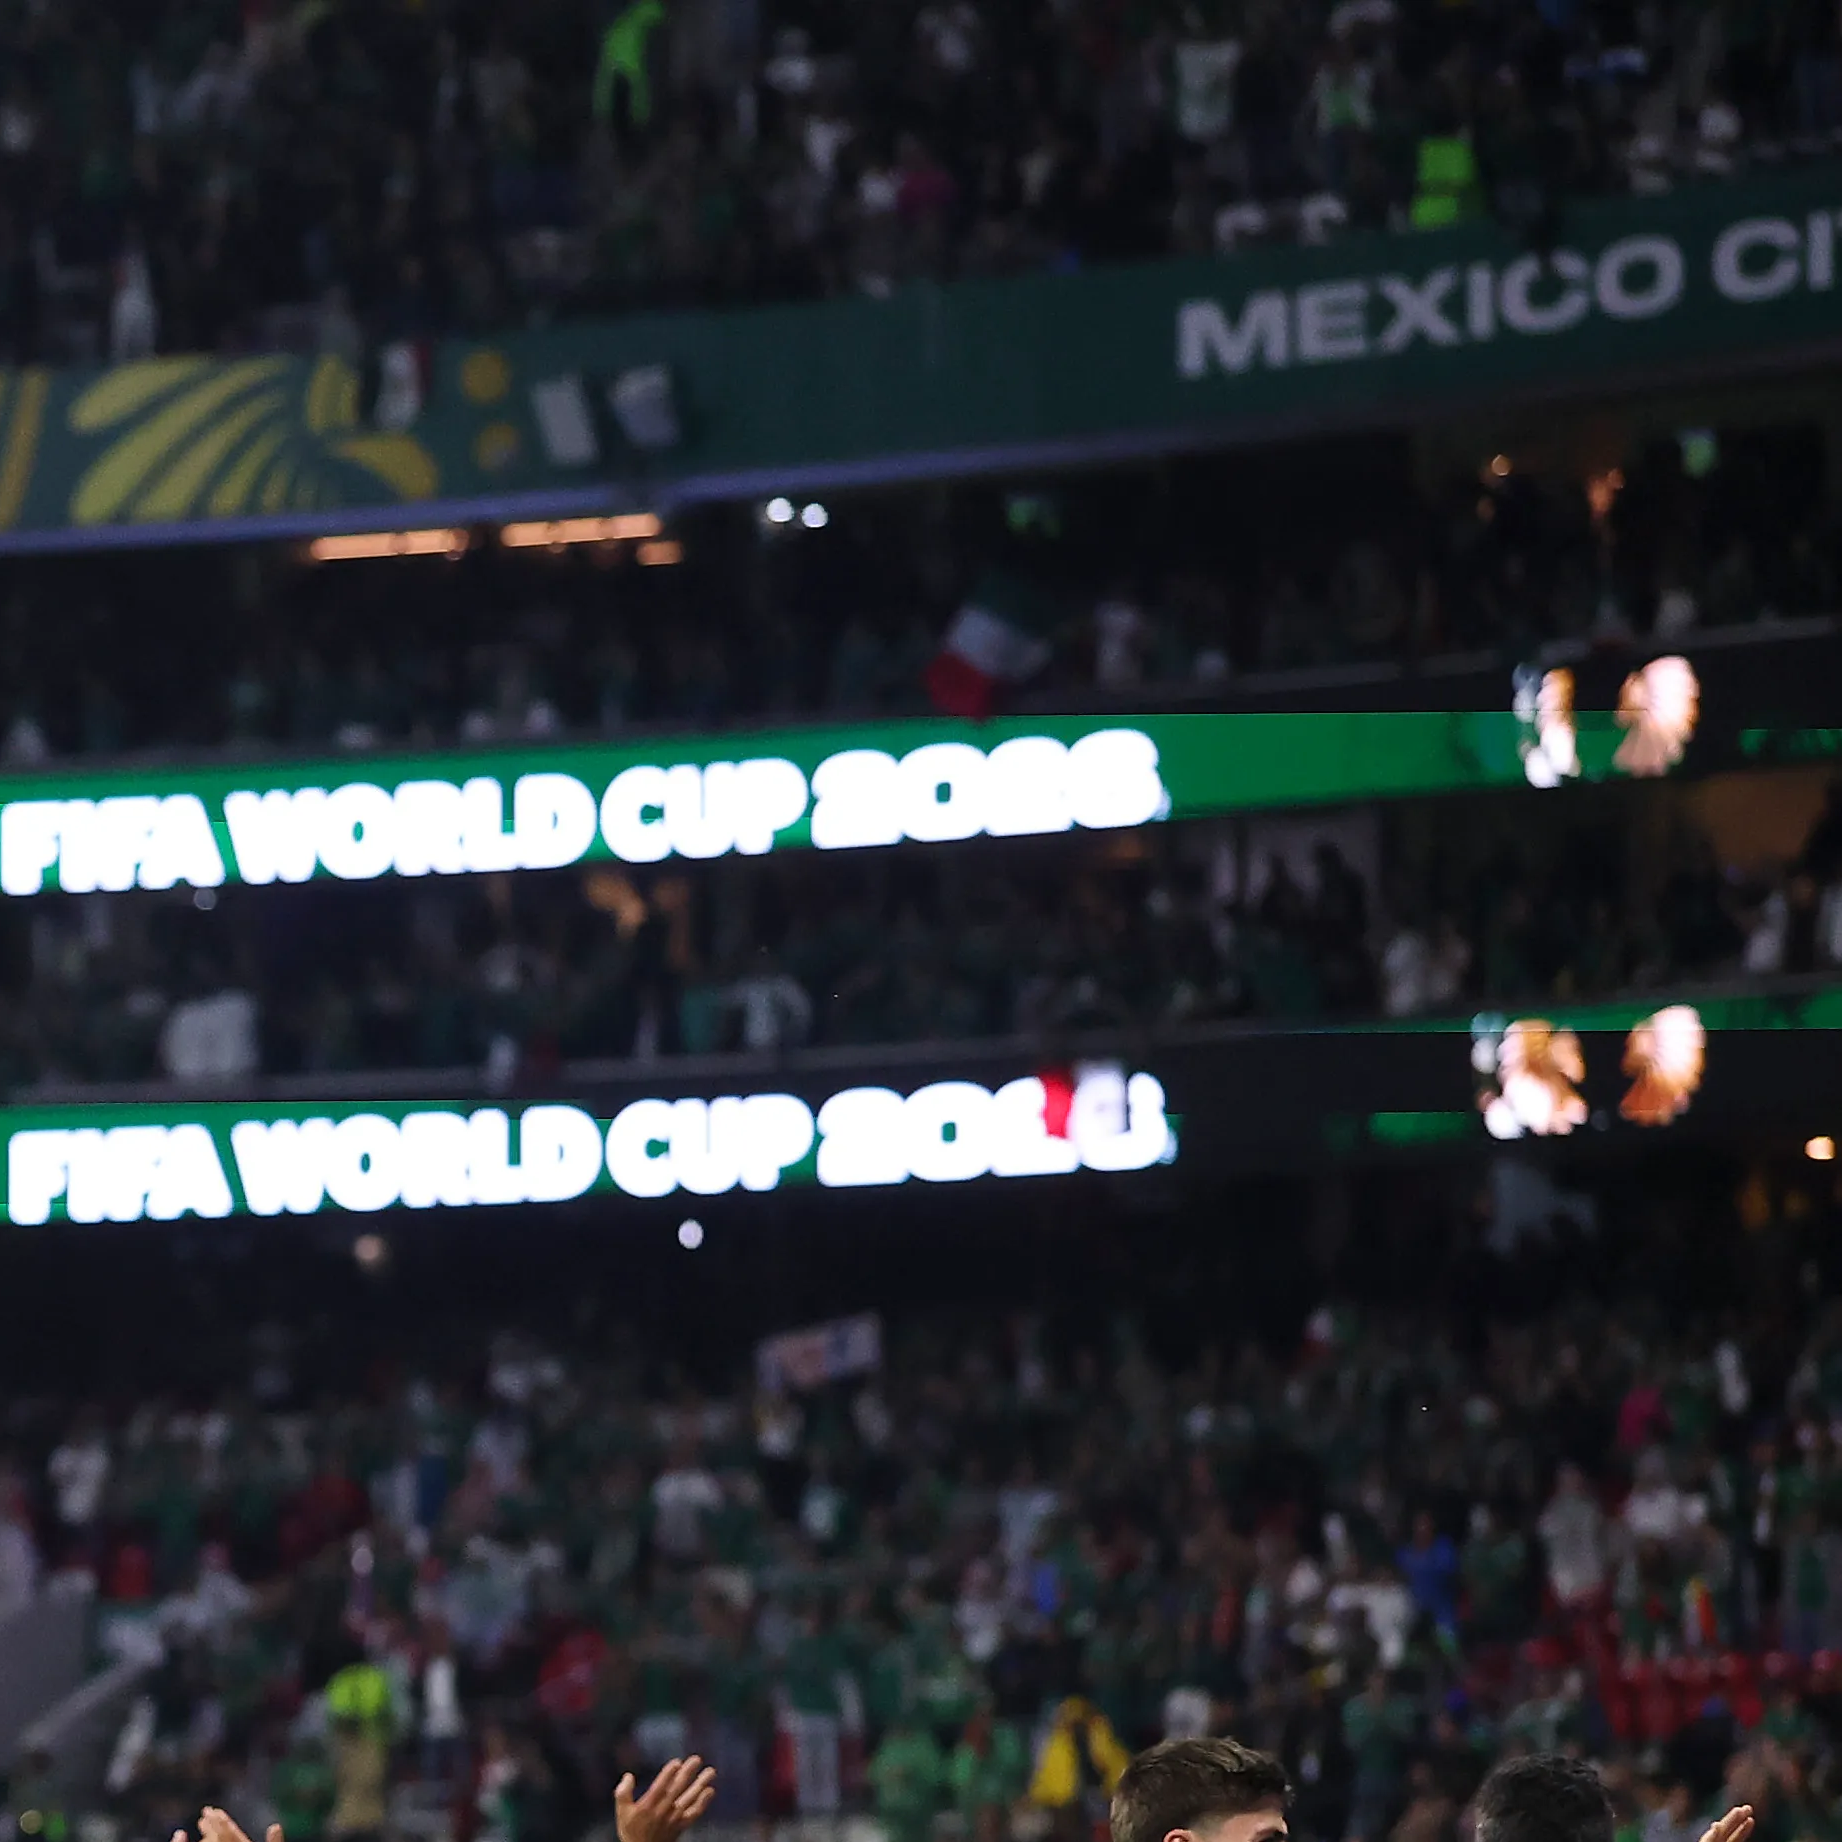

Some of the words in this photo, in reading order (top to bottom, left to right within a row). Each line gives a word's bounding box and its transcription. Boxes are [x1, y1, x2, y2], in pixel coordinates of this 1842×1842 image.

[1175, 232, 1686, 381] MEXICO
[1711, 207, 1842, 303] CI
[0, 793, 226, 896] FIFA
[224, 773, 595, 885] WORLD
[601, 757, 809, 863] CUP
[811, 728, 1163, 850] 2026
[7, 1122, 233, 1226] FIFA
[231, 1106, 603, 1215] WORLD
[606, 1091, 814, 1196] CUP
